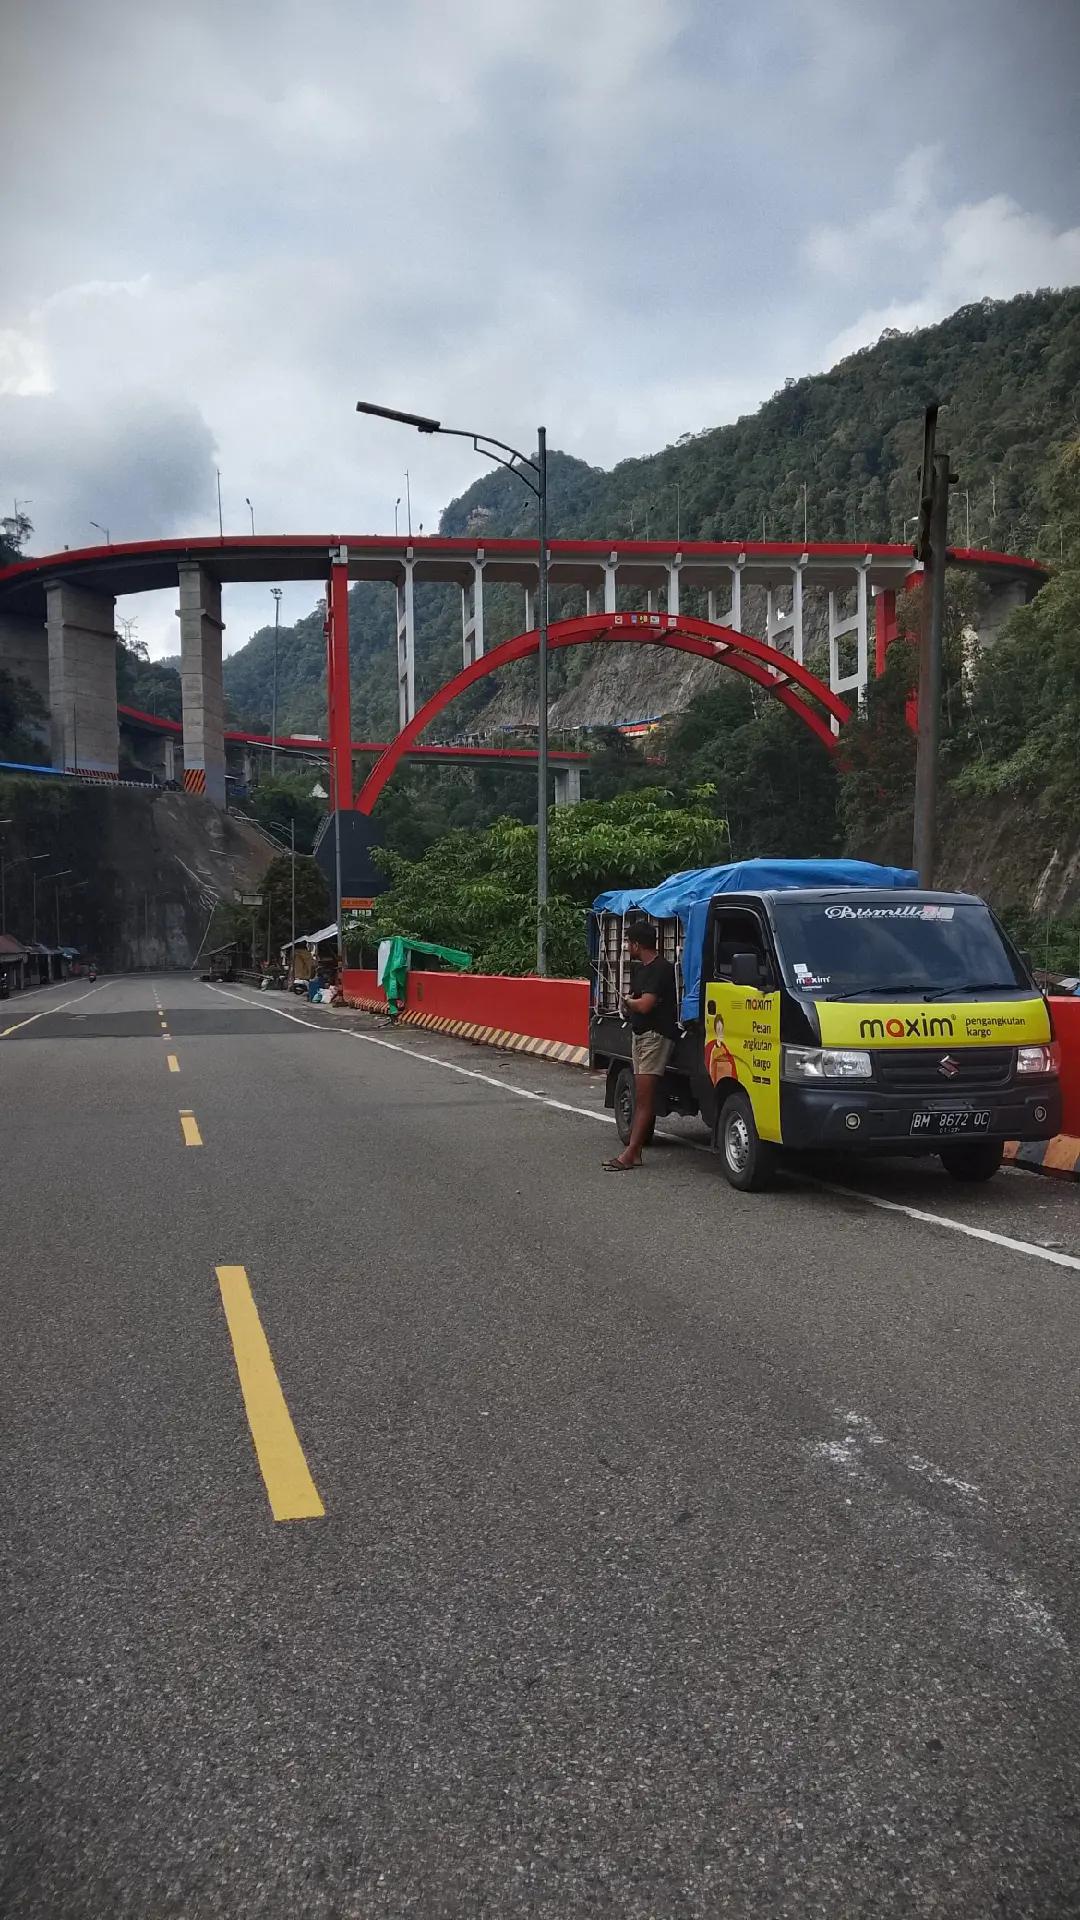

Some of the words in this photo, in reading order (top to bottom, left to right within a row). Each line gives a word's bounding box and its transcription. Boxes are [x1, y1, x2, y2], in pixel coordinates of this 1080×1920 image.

[796, 976, 829, 986] maxim
[745, 998, 773, 1011] maxim
[752, 1021, 772, 1034] Pesan
[859, 1012, 954, 1038] maxim
[965, 1016, 1026, 1027] pengangkutan
[966, 1026, 992, 1038] kargo
[742, 1038, 772, 1052] angkutan
[752, 1055, 771, 1071] kargo
[913, 1114, 931, 1128] BM
[939, 1113, 969, 1127] 8672
